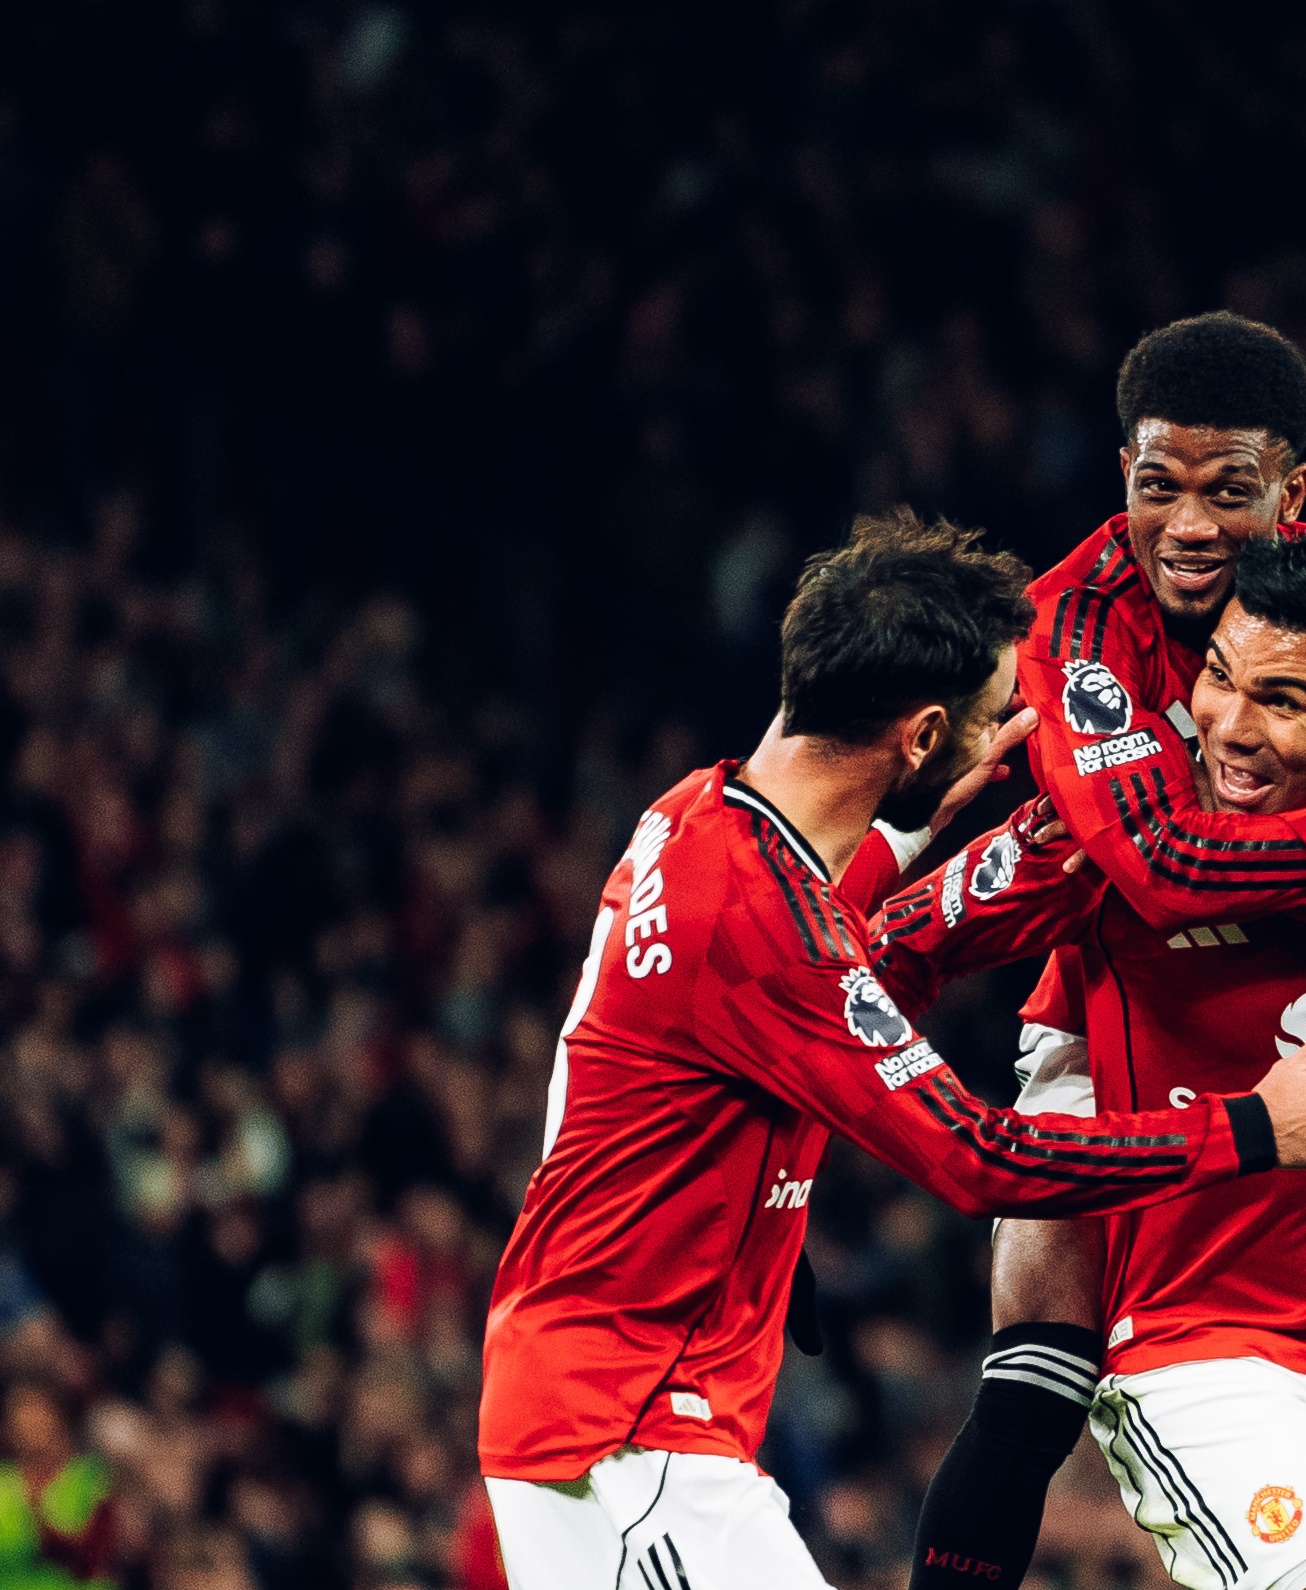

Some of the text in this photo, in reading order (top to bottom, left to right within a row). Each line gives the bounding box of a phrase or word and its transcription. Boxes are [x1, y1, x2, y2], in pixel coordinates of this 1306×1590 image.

[1073, 731, 1150, 761] No room
[1077, 741, 1162, 777] for racism
[950, 872, 963, 916] room
[874, 1057, 902, 1075] No
[883, 1067, 911, 1091] for
